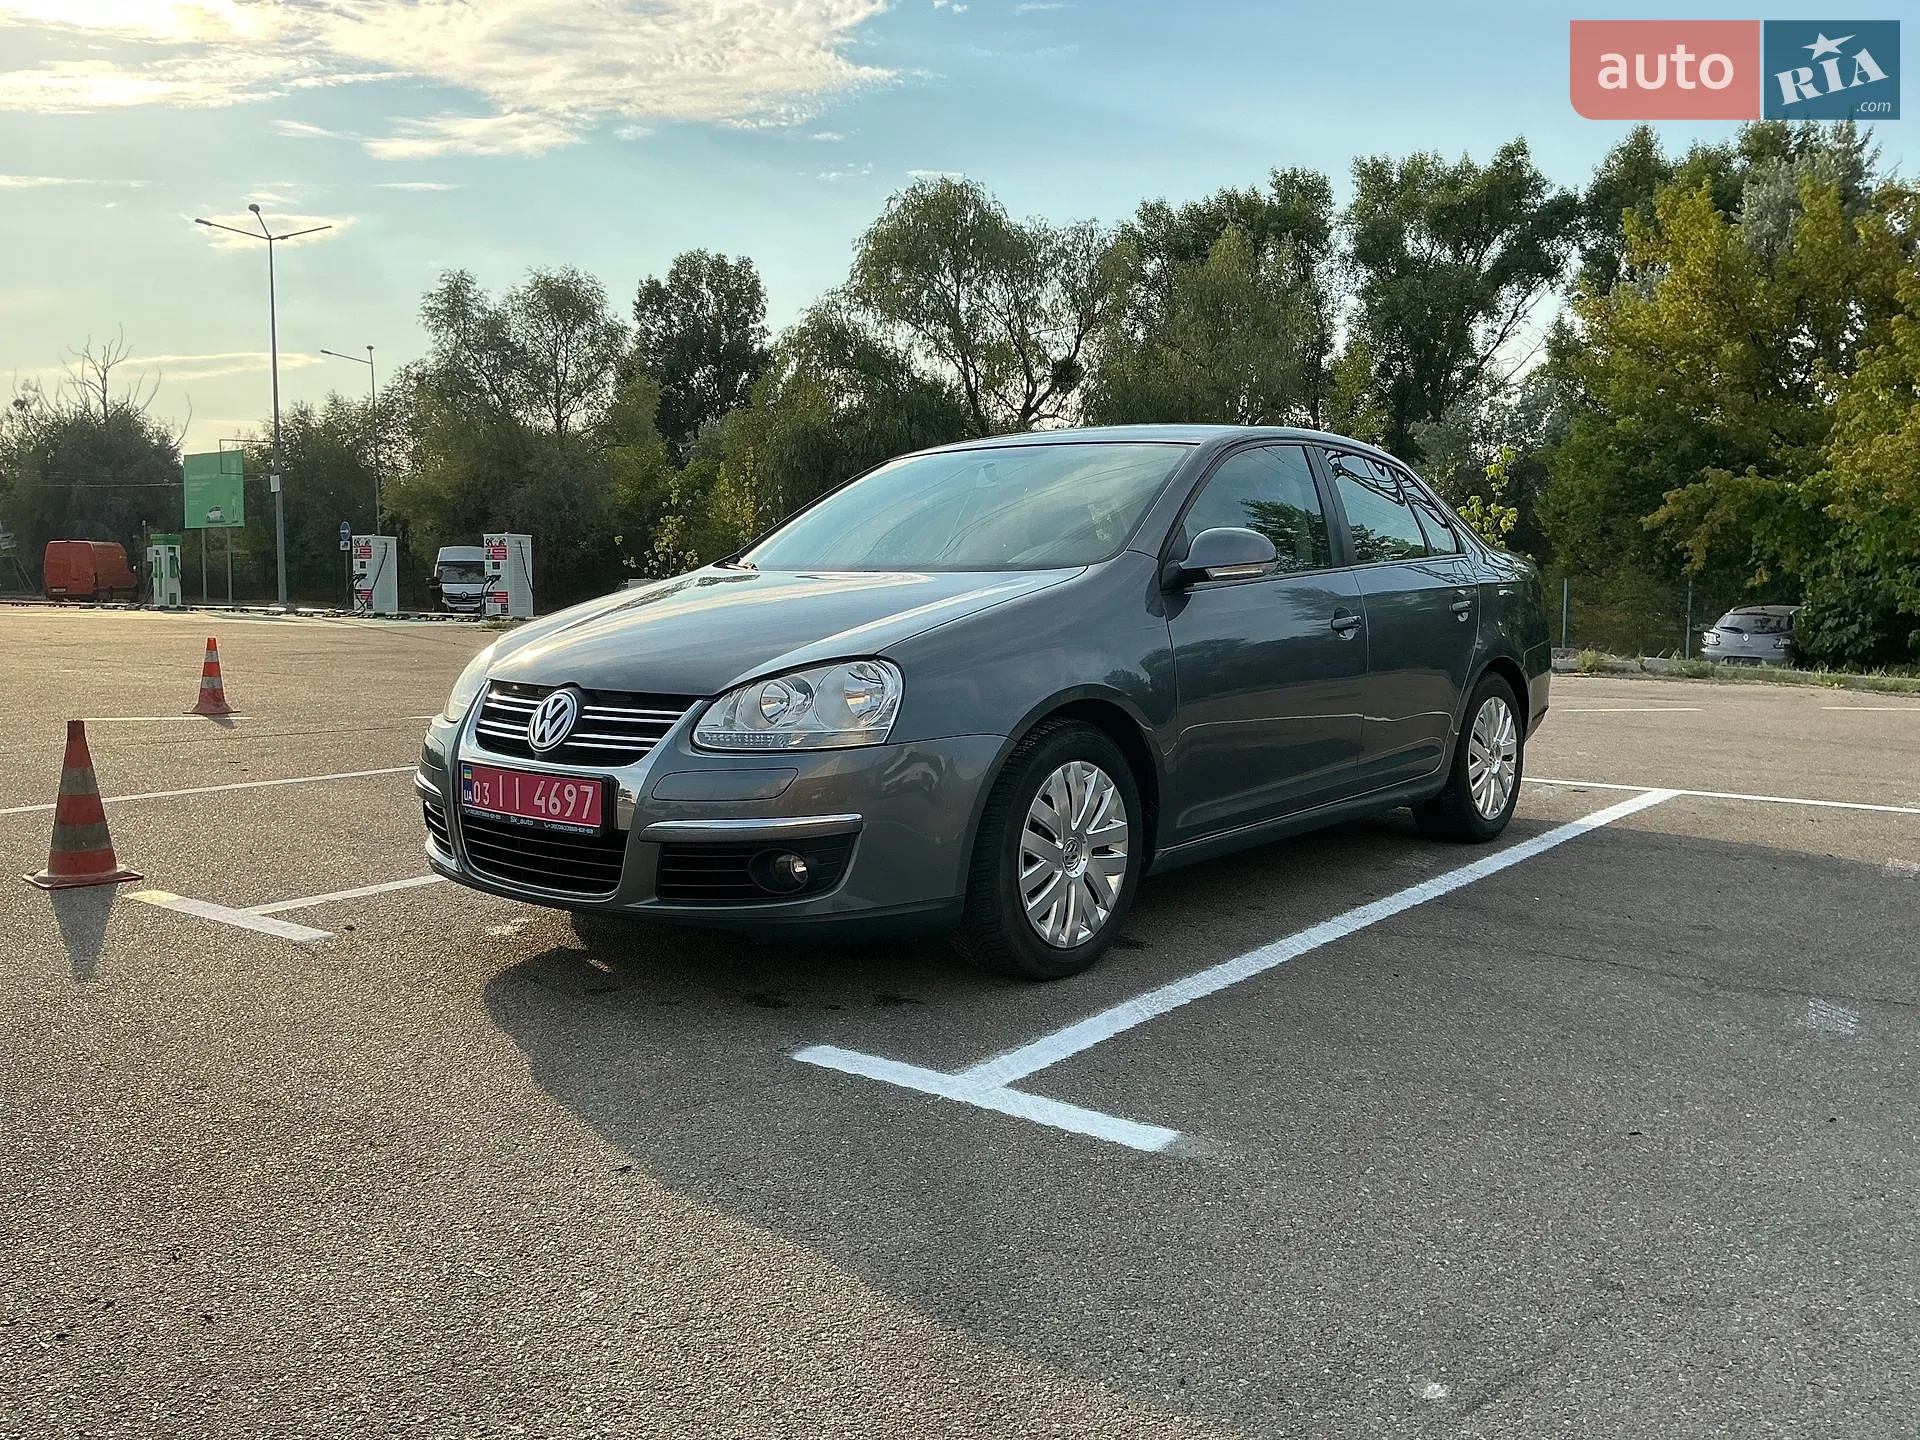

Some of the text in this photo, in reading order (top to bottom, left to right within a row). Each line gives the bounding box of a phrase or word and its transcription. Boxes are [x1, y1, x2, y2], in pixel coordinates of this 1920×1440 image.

[463, 789, 473, 802] UA
[473, 780, 491, 805] 03
[533, 780, 594, 820] 4697
